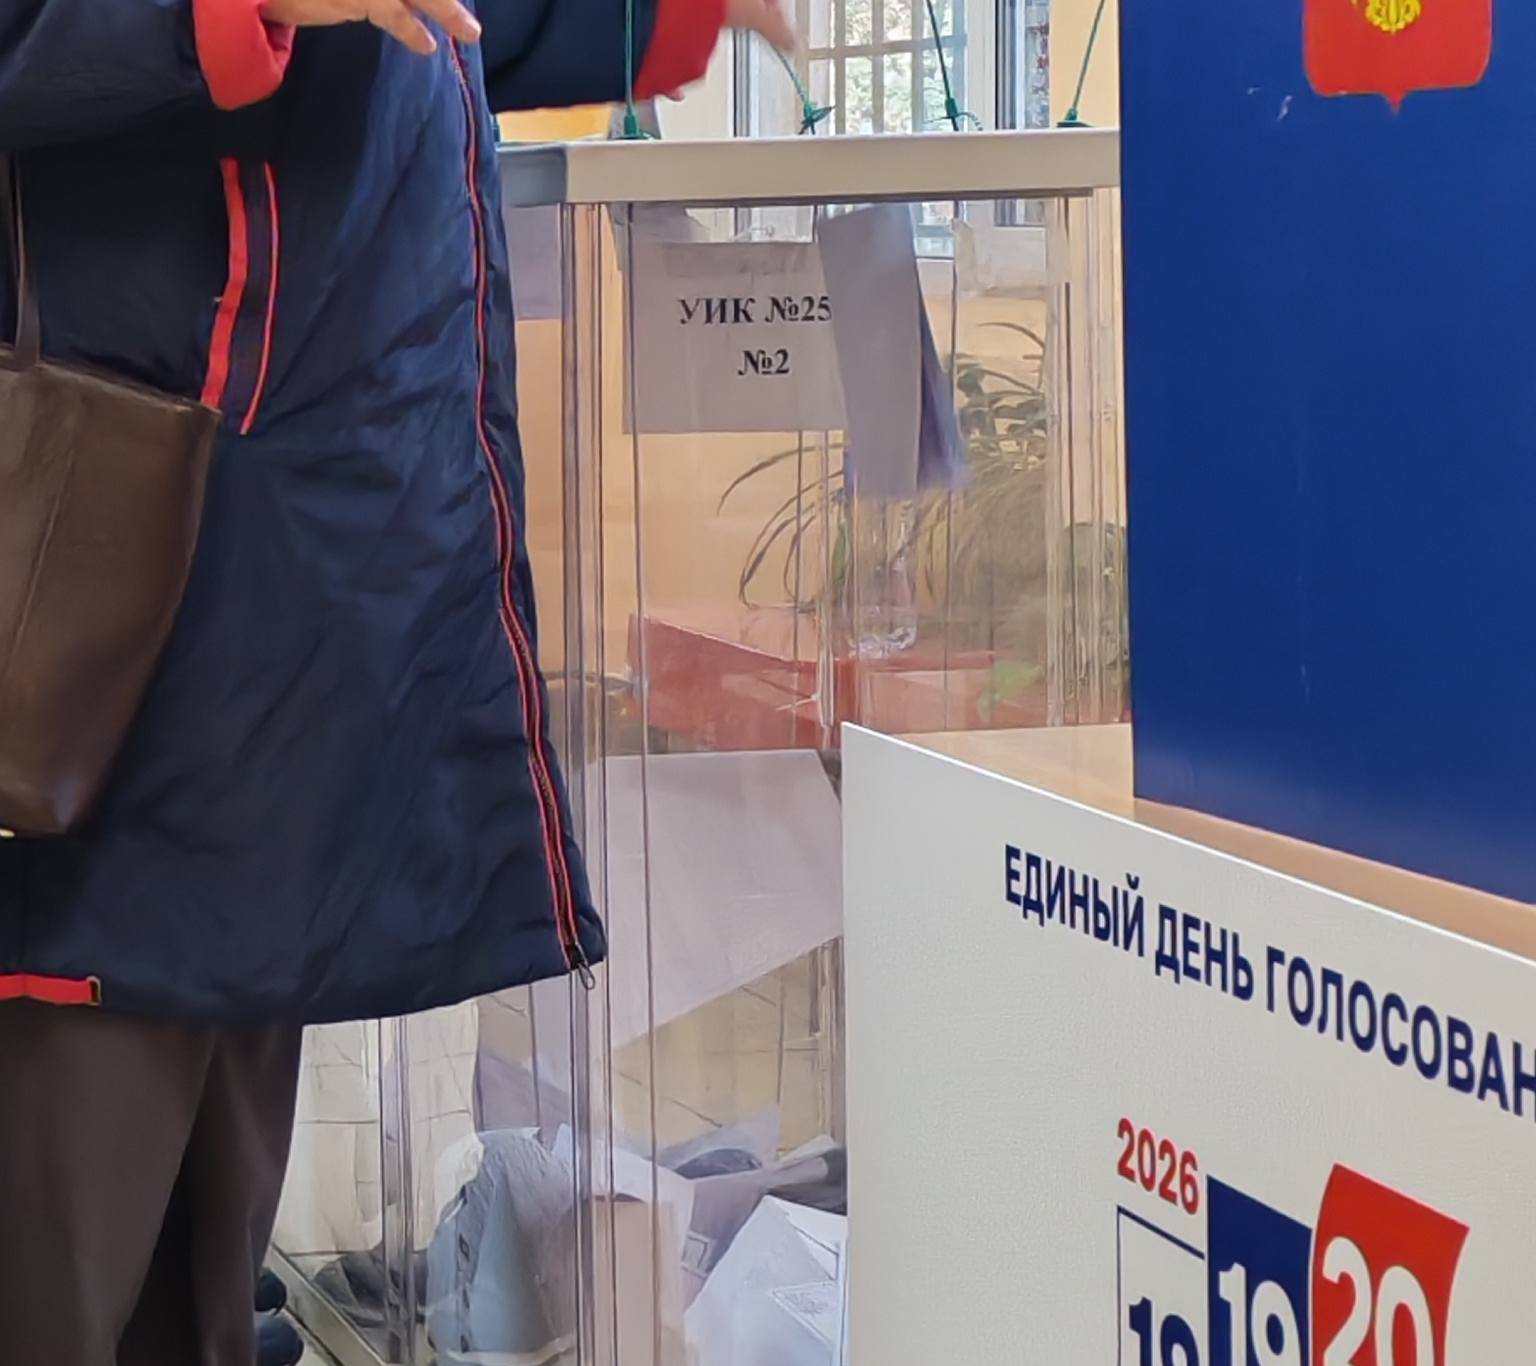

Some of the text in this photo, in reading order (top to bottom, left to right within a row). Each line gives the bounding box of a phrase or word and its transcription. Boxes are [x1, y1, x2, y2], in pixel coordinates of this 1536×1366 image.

[677, 295, 832, 325] УИК №25
[737, 348, 791, 376] №2
[1005, 842, 1145, 958] ЕДИНЫЙ
[1154, 903, 1255, 1003] ДЕНЬ
[1117, 1117, 1200, 1215] 2026
